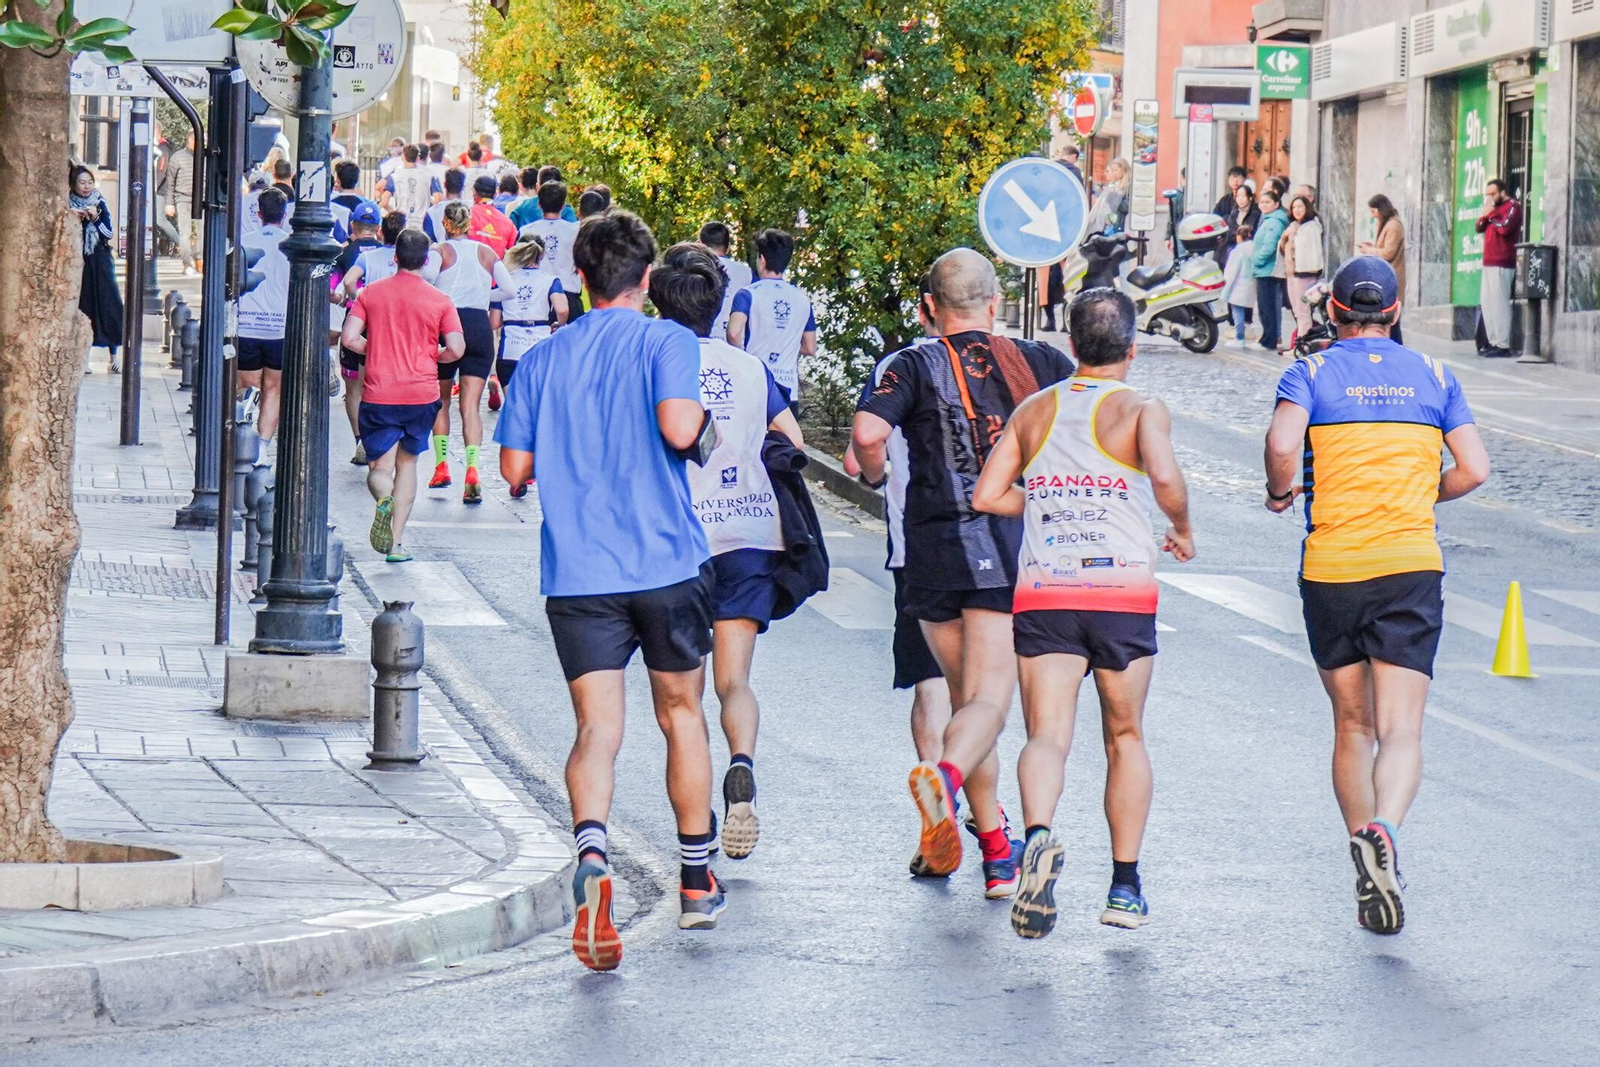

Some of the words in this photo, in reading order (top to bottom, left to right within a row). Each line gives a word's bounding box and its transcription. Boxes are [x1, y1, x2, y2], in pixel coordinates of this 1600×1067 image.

[1262, 74, 1302, 84] Carrefour
[1268, 84, 1296, 93] express
[1466, 109, 1480, 149] 9h
[1482, 126, 1488, 146] a
[1464, 157, 1486, 198] 22h
[1346, 384, 1415, 400] agustinos
[1028, 475, 1128, 490] GRANADA
[1028, 489, 1129, 501] RUNNERS
[701, 506, 774, 524] GRANADA
[1057, 532, 1106, 544] BIONER
